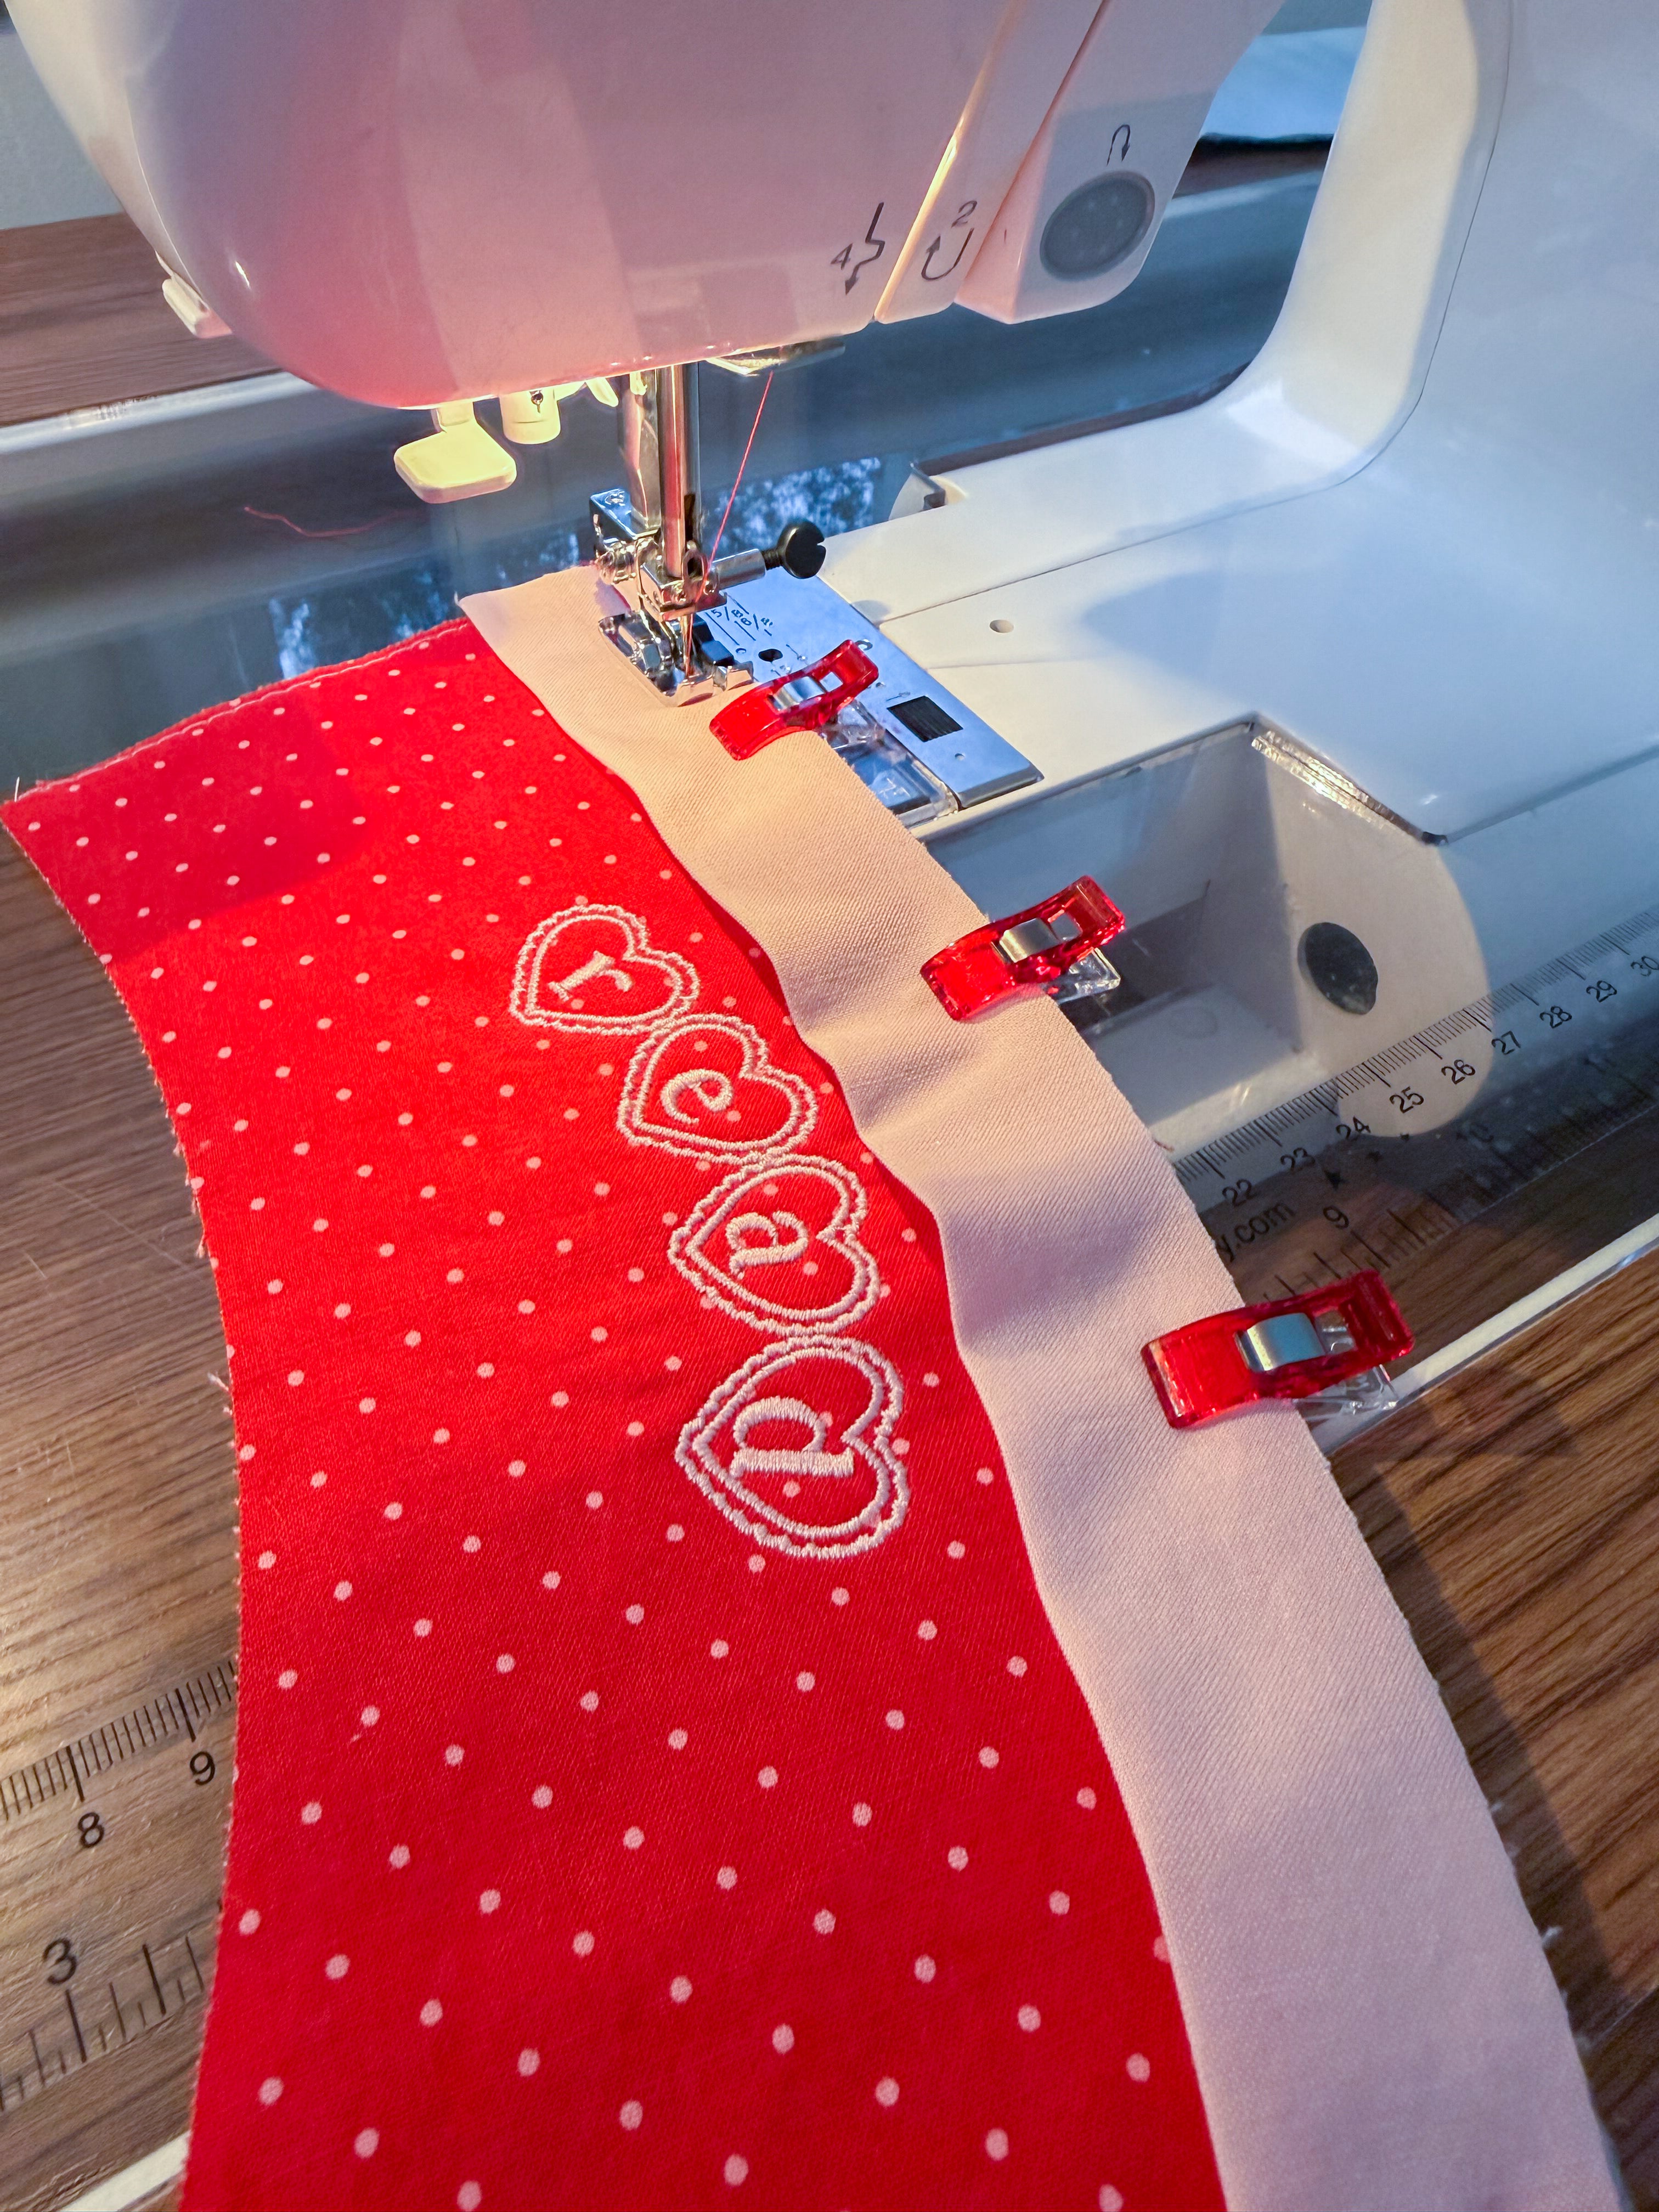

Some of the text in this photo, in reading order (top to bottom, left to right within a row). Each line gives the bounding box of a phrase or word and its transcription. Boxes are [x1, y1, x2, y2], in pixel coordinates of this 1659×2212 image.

[951, 201, 977, 228] 2
[831, 244, 853, 269] 4
[1222, 955, 1659, 1206] 22 23 24 25 26 27 28 29 30
[1323, 1205, 1350, 1229] 9
[77, 1751, 216, 1848] 8 9
[42, 1937, 77, 1985] 3
